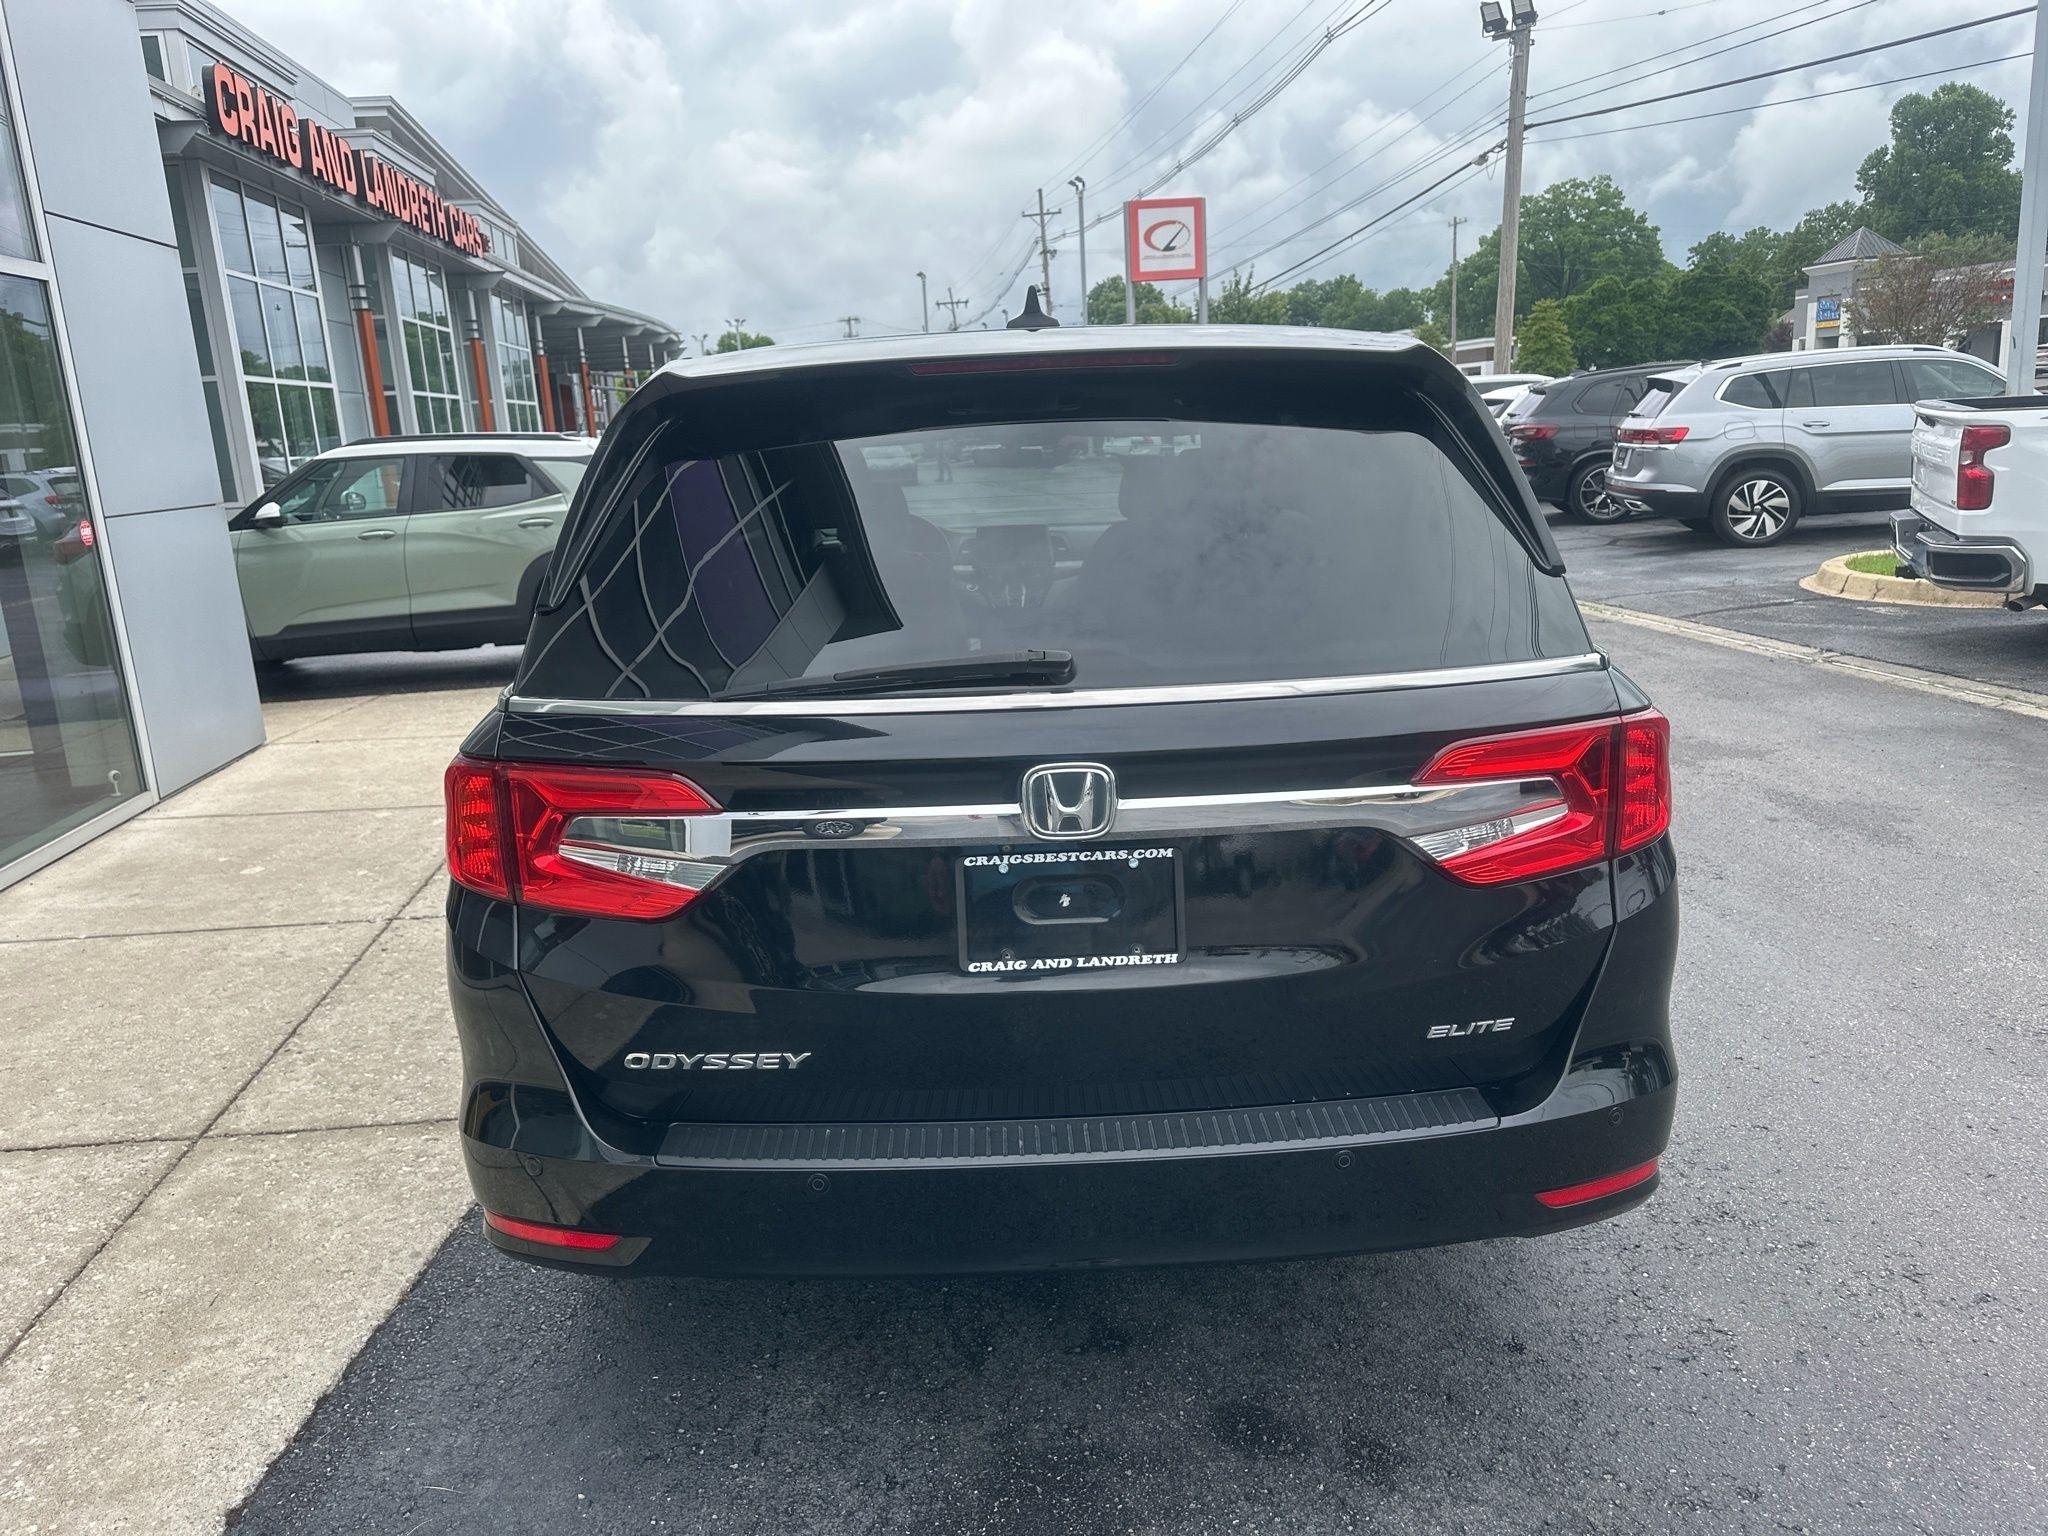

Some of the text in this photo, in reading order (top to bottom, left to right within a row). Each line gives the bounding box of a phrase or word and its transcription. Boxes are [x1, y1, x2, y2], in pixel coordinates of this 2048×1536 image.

[211, 62, 485, 259] CRAIG AND LANDRETH CARS
[963, 848, 1174, 867] CRAIGSBESTCARS.COM
[967, 953, 1178, 973] CRAIG AND LANDRETH
[1426, 1017, 1516, 1039] ELITE
[623, 1052, 812, 1070] ODYSSEY
